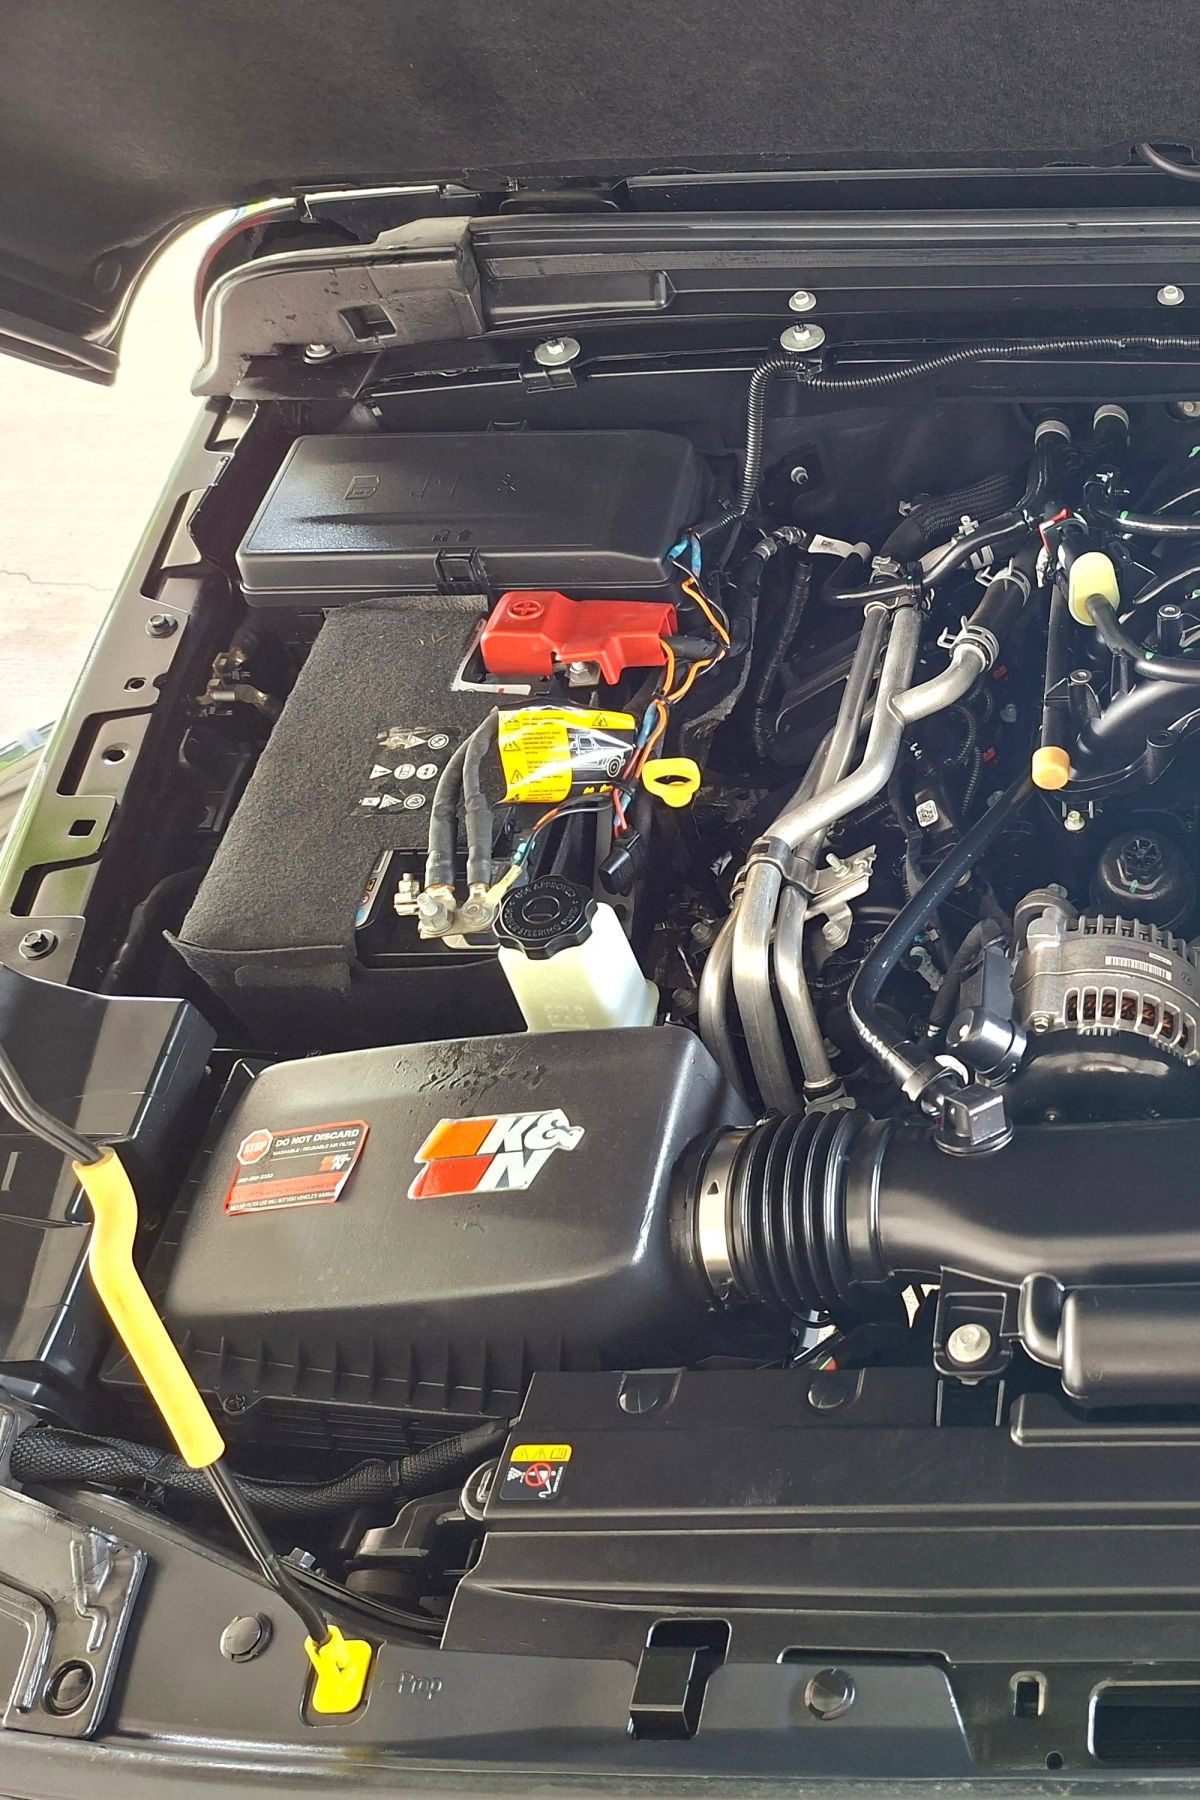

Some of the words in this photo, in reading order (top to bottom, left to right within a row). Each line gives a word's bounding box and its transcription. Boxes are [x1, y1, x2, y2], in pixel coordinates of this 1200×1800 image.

[275, 1138, 290, 1147] DO
[291, 1134, 312, 1145] NOT
[313, 1129, 360, 1141] DISCARD
[398, 1670, 442, 1700] Prop
